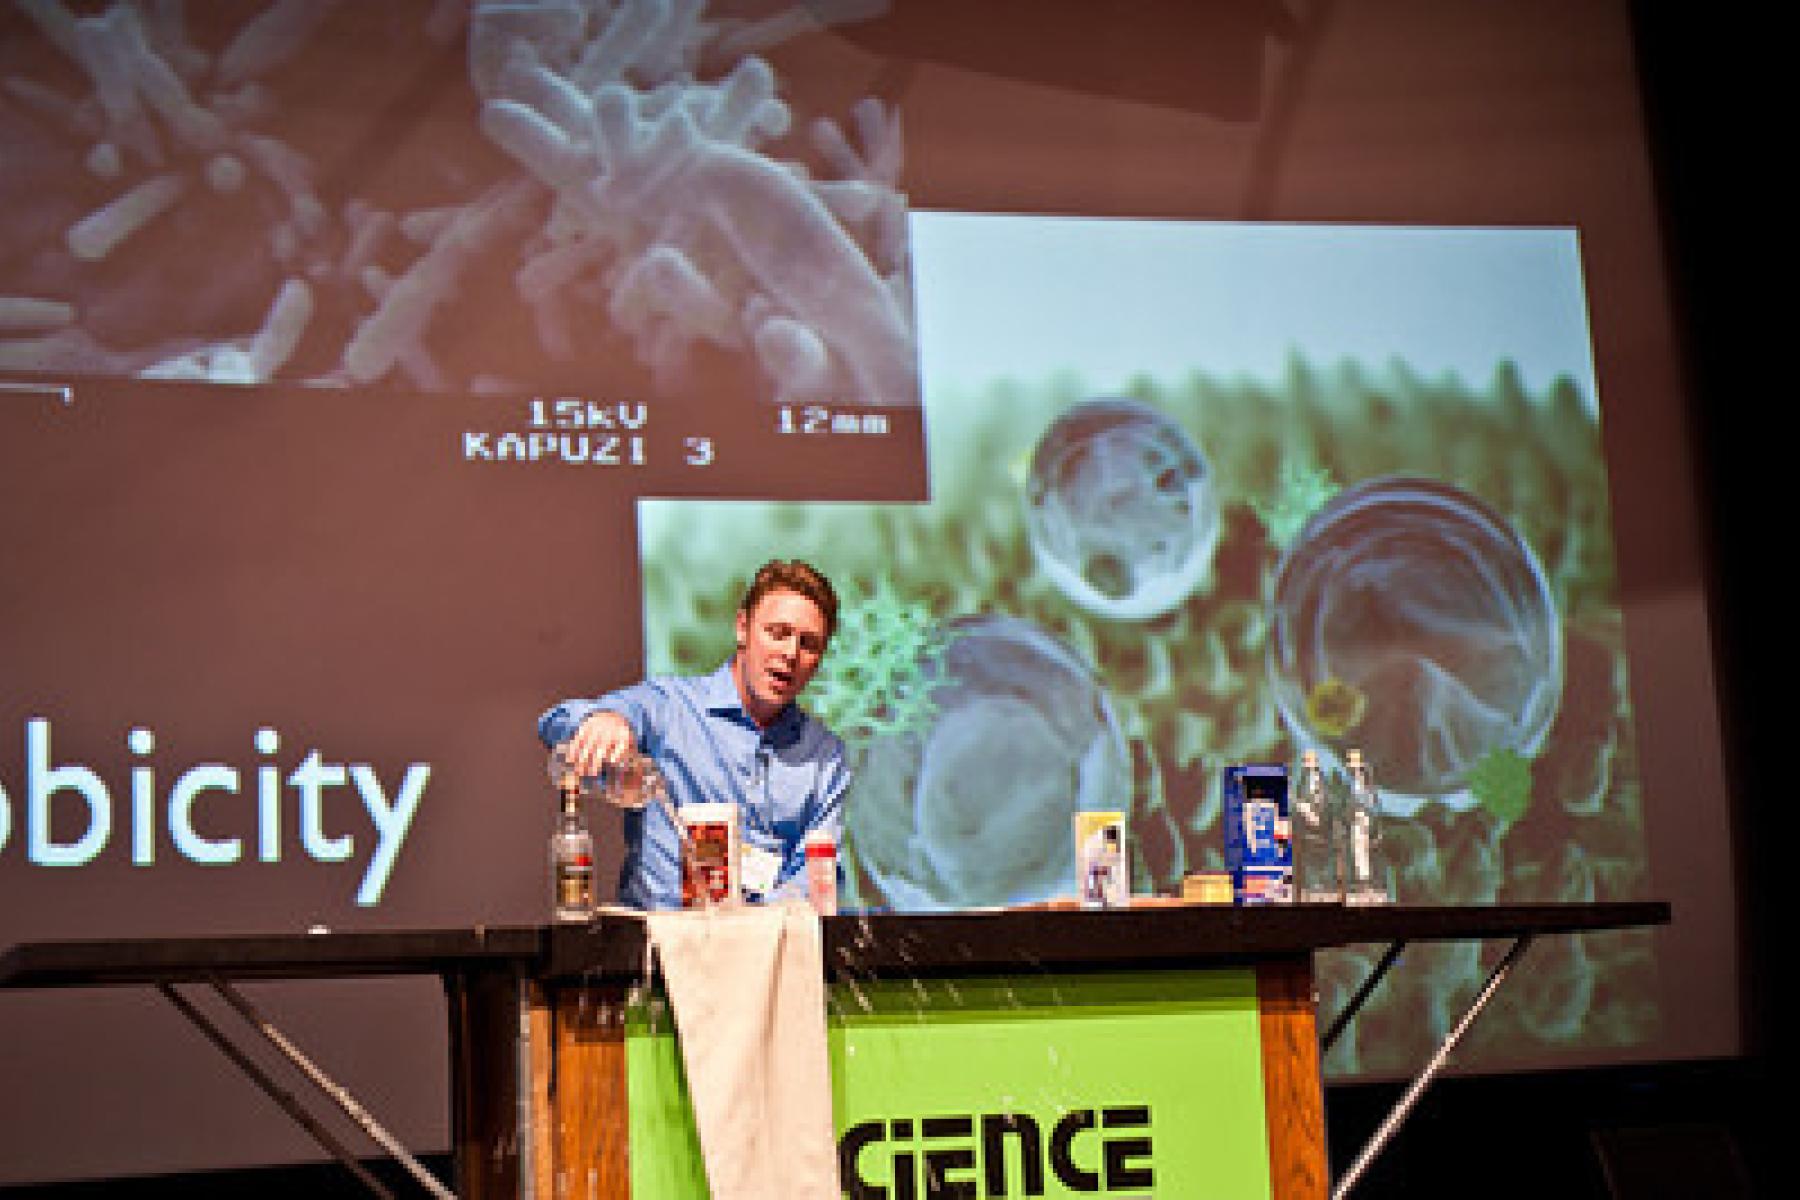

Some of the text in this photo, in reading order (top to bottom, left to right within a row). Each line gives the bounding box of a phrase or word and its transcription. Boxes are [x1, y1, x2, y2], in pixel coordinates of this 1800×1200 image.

[529, 397, 890, 434] 15kV 12mm
[683, 436, 716, 466] 3
[0, 716, 431, 907] bicity
